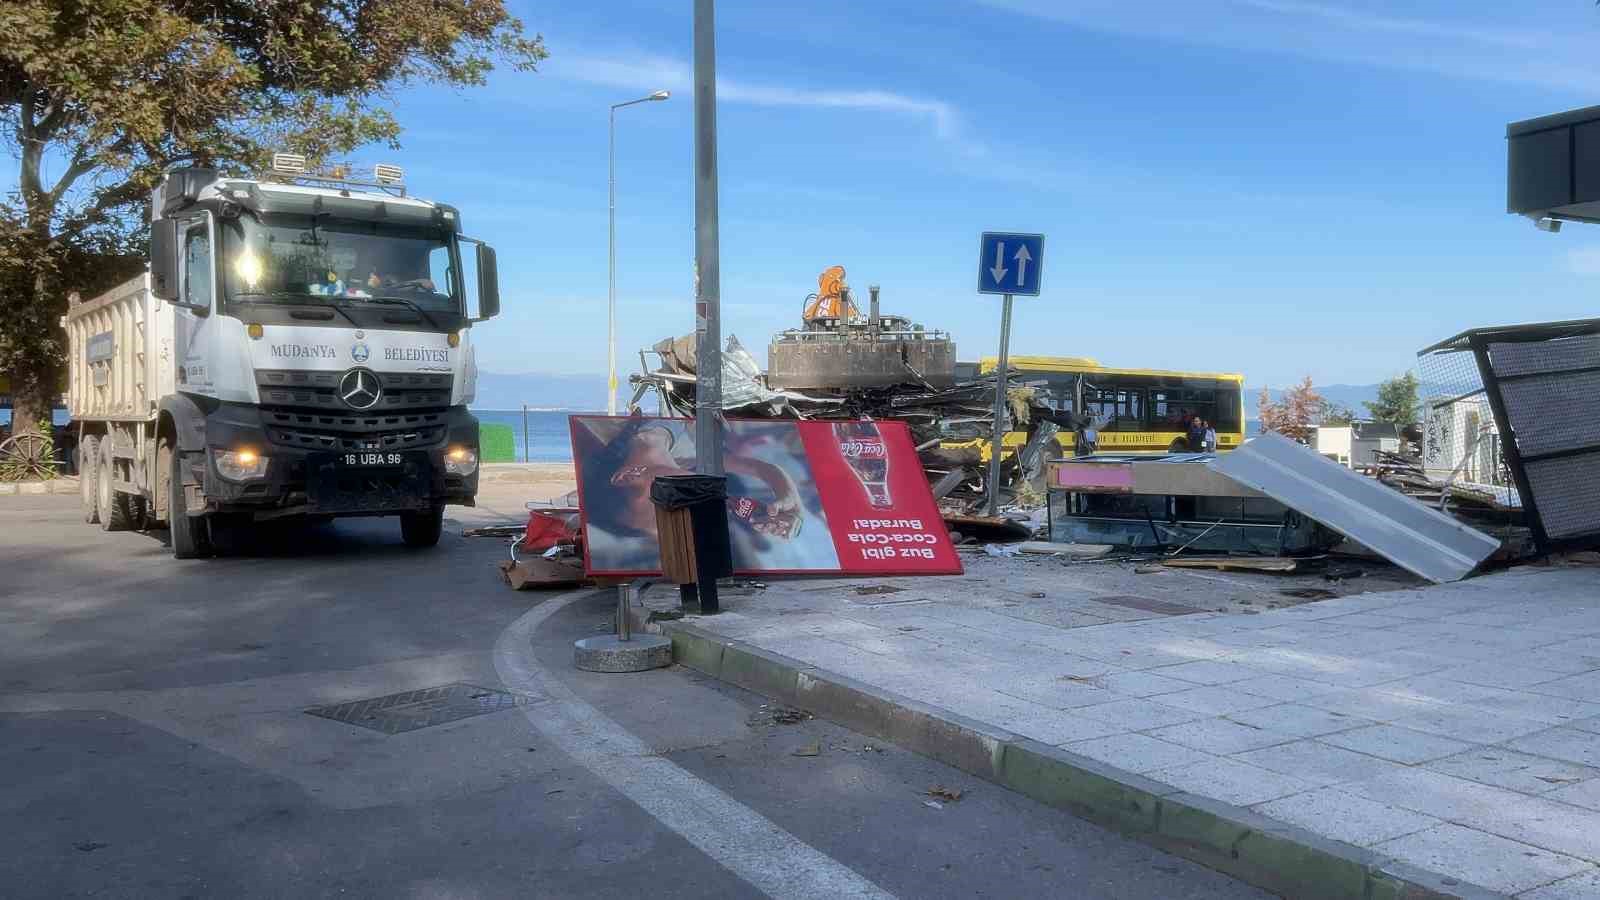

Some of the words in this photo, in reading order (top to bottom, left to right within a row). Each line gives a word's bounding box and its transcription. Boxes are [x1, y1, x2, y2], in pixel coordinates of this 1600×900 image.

[271, 344, 337, 358] MUDANYA
[384, 346, 449, 362] BELEDİYESİ
[345, 454, 356, 465] 16
[360, 454, 385, 465] UBA
[387, 454, 401, 464] 96
[853, 519, 924, 530] Burada!
[848, 533, 937, 544] Coca-Cola
[861, 546, 897, 560] gibi
[901, 548, 936, 559] Buz
